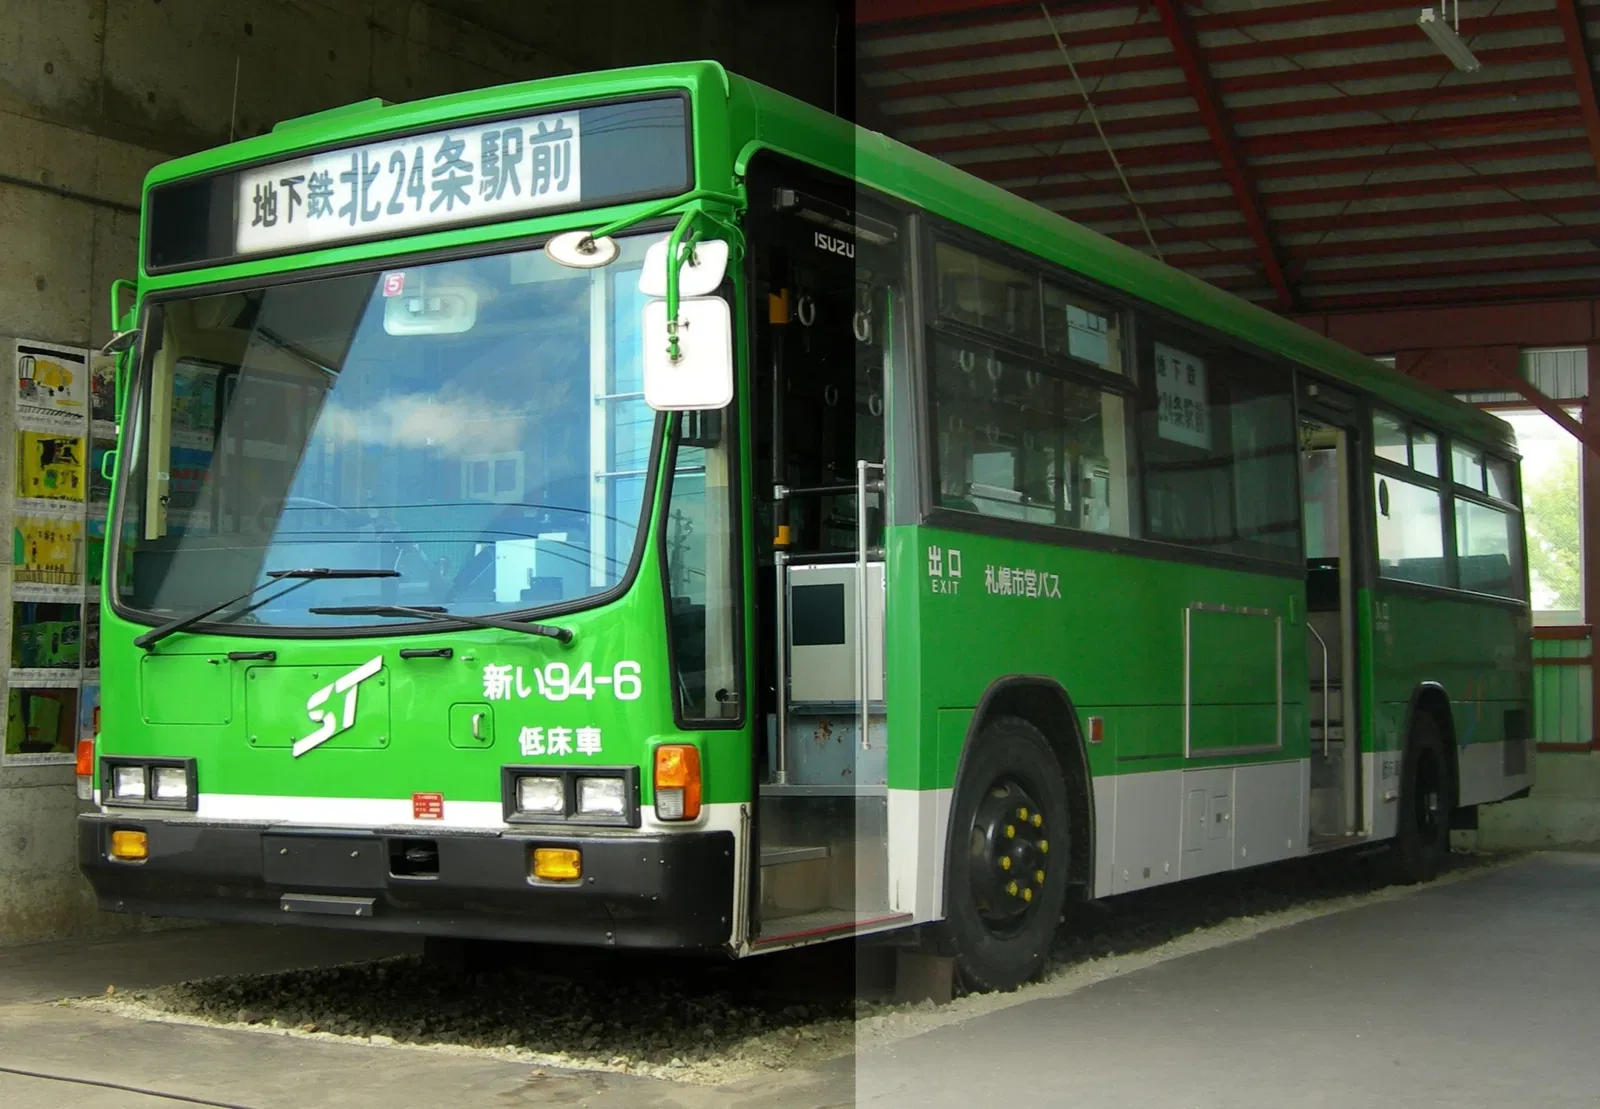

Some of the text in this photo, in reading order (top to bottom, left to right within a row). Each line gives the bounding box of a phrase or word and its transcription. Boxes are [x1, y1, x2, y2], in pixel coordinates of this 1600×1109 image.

[814, 231, 855, 258] ISUZU
[387, 274, 401, 293] 5
[928, 545, 962, 578] 出口
[931, 579, 959, 595] EXIT
[985, 565, 1061, 599] 札幌市営バス
[518, 726, 603, 757] 低床車
